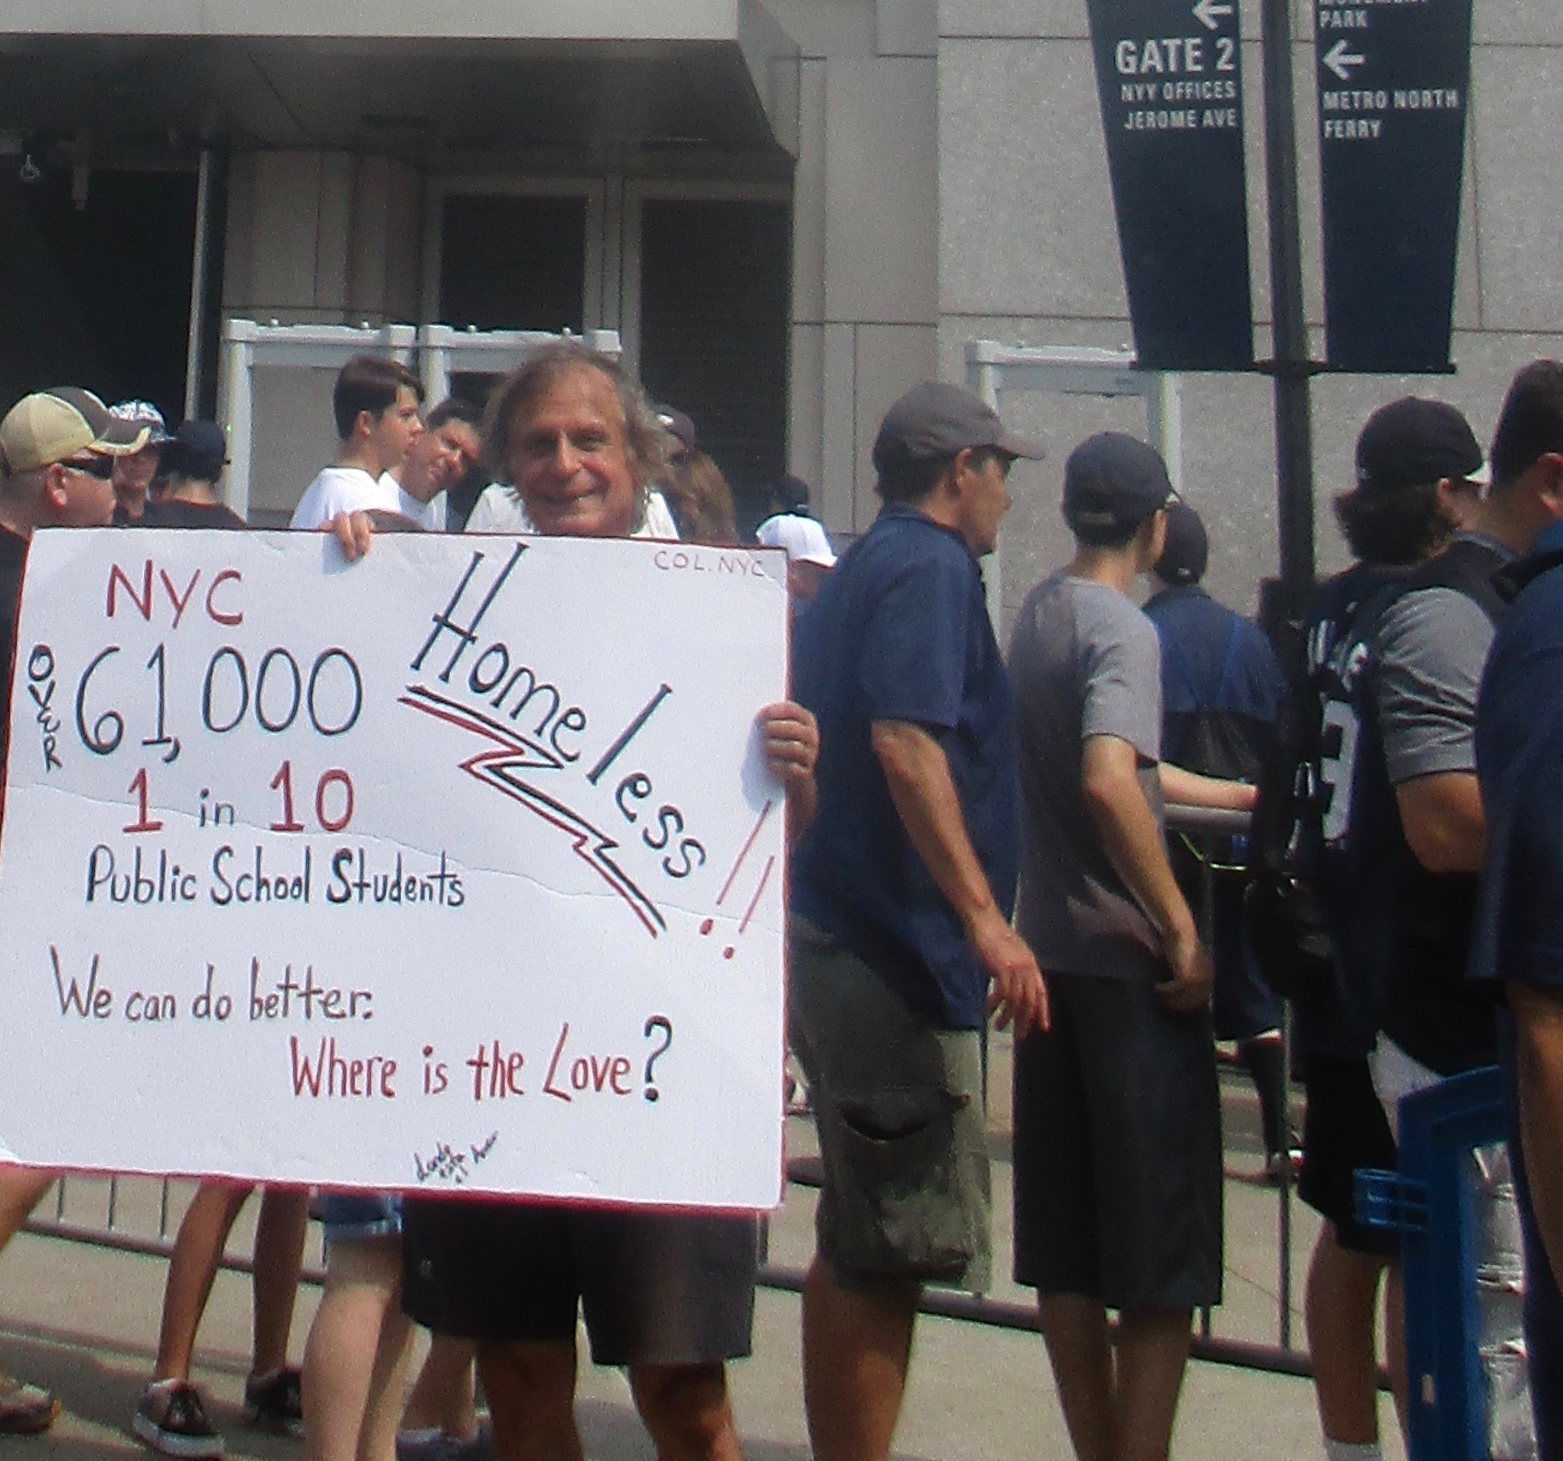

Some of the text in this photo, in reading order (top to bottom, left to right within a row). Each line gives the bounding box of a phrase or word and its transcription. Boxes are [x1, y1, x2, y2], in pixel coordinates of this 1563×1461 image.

[1319, 9, 1368, 28] PARK
[1115, 36, 1235, 75] GATE 2
[1121, 81, 1236, 101] NYY OFFICES
[1322, 88, 1460, 110] METRO NORTH
[1124, 108, 1237, 130] JEROME AVE
[1324, 118, 1383, 139] FERRY
[105, 563, 245, 629] NYC
[75, 641, 364, 764] 61,000
[122, 759, 355, 834] 1 in 10
[85, 843, 466, 907] Public School Students
[48, 943, 114, 1021] We
[124, 987, 177, 1021] can
[191, 962, 233, 1021] do
[289, 1034, 398, 1100] Where
[422, 1044, 449, 1096] is
[466, 1040, 526, 1101] the
